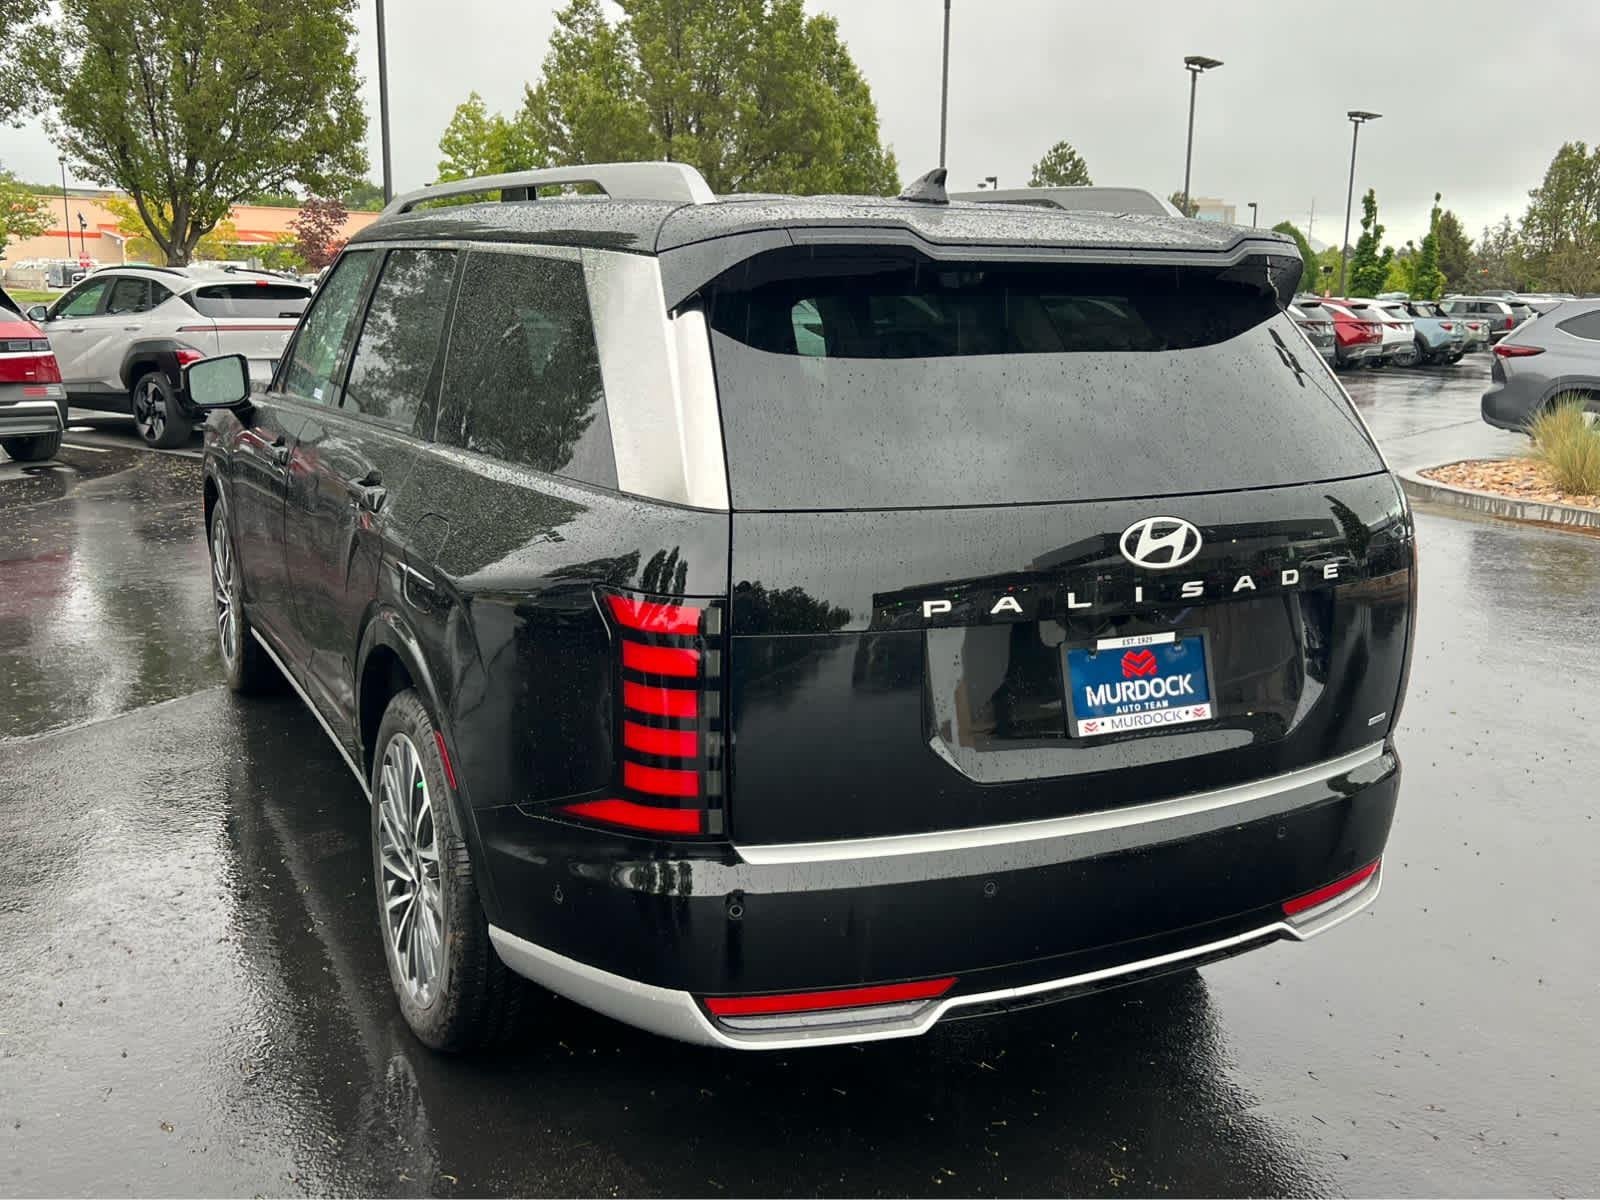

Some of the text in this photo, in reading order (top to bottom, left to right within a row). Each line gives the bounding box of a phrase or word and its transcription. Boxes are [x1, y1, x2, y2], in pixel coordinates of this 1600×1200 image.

[922, 563, 1340, 618] PALISADE
[1085, 673, 1195, 707] MURDOCK
[1111, 710, 1183, 730] MURDOCK
[1115, 699, 1169, 714] AUTO TEAM
